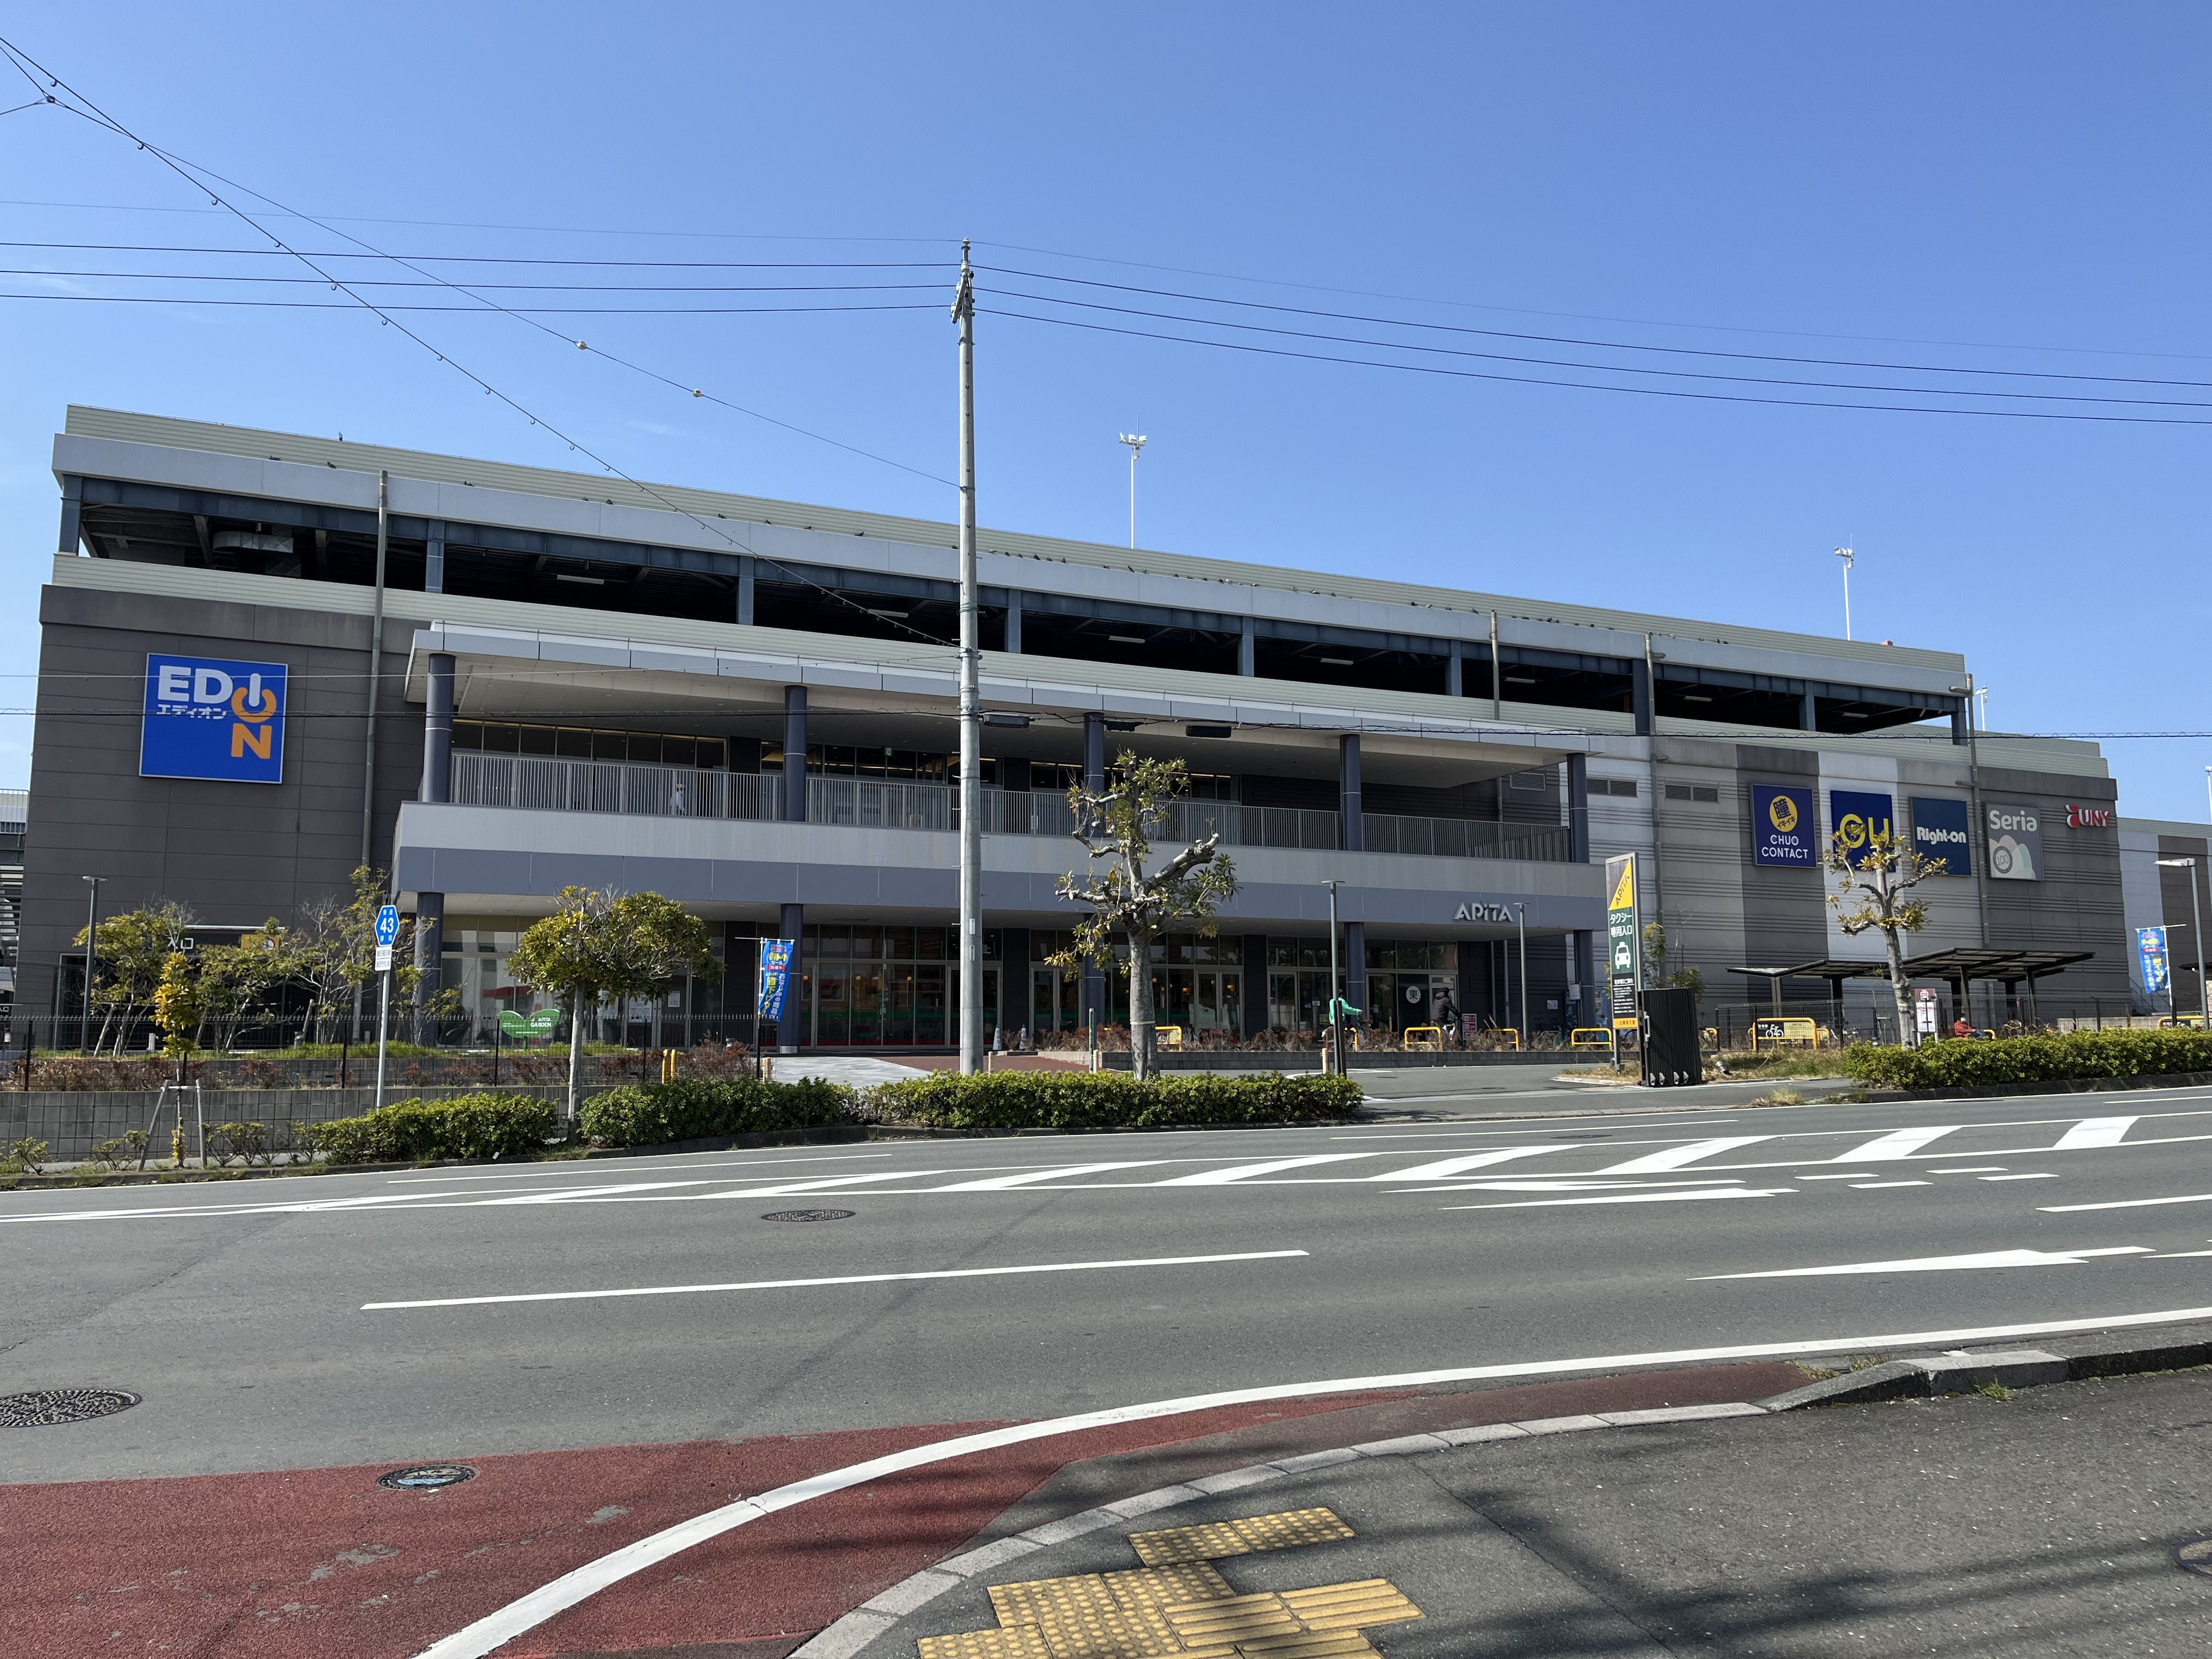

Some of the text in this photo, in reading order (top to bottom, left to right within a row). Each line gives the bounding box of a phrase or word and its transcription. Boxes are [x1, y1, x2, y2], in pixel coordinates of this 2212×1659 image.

[156, 704, 227, 719] エディオン
[1773, 798, 1791, 820] 瞳
[1989, 810, 2037, 832] Seria
[1839, 814, 1889, 848] GU
[1916, 826, 1966, 845] Right-on
[1770, 834, 1798, 845] CHUO
[1762, 847, 1808, 859] CONTACT
[1996, 854, 2008, 866] 100
[1615, 875, 1630, 907] APITA
[380, 917, 394, 933] 43
[1610, 912, 1632, 924] タクシー
[1610, 925, 1633, 938] 専用入口
[1408, 990, 1418, 1000] 東
